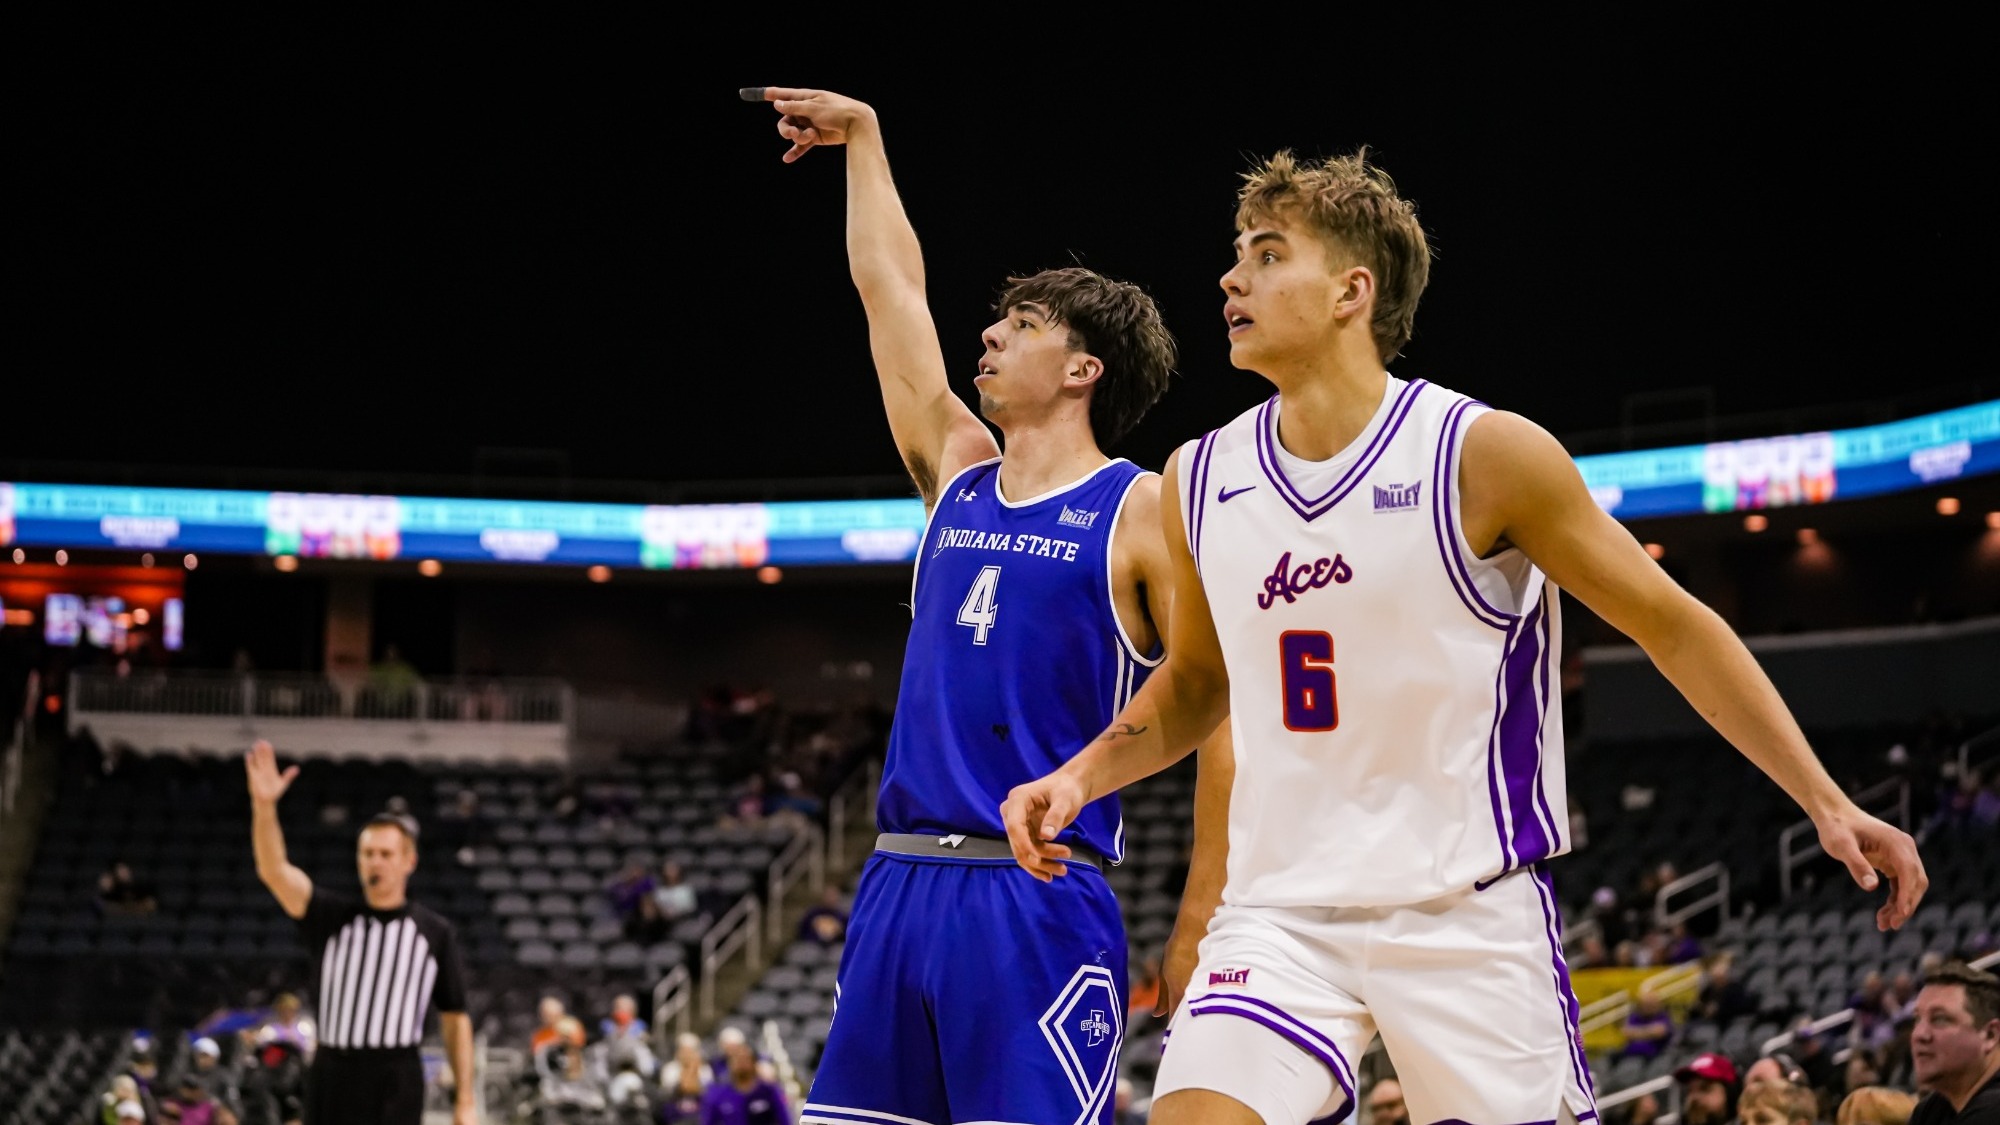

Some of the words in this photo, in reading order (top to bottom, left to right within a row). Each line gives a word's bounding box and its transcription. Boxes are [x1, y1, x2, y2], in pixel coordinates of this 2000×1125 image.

[1373, 480, 1422, 509] VALLEY
[1058, 504, 1100, 527] VALLEY
[934, 527, 1011, 555] INDIANA
[1013, 534, 1080, 563] STATE
[956, 565, 1002, 646] 4
[1279, 630, 1339, 732] 6
